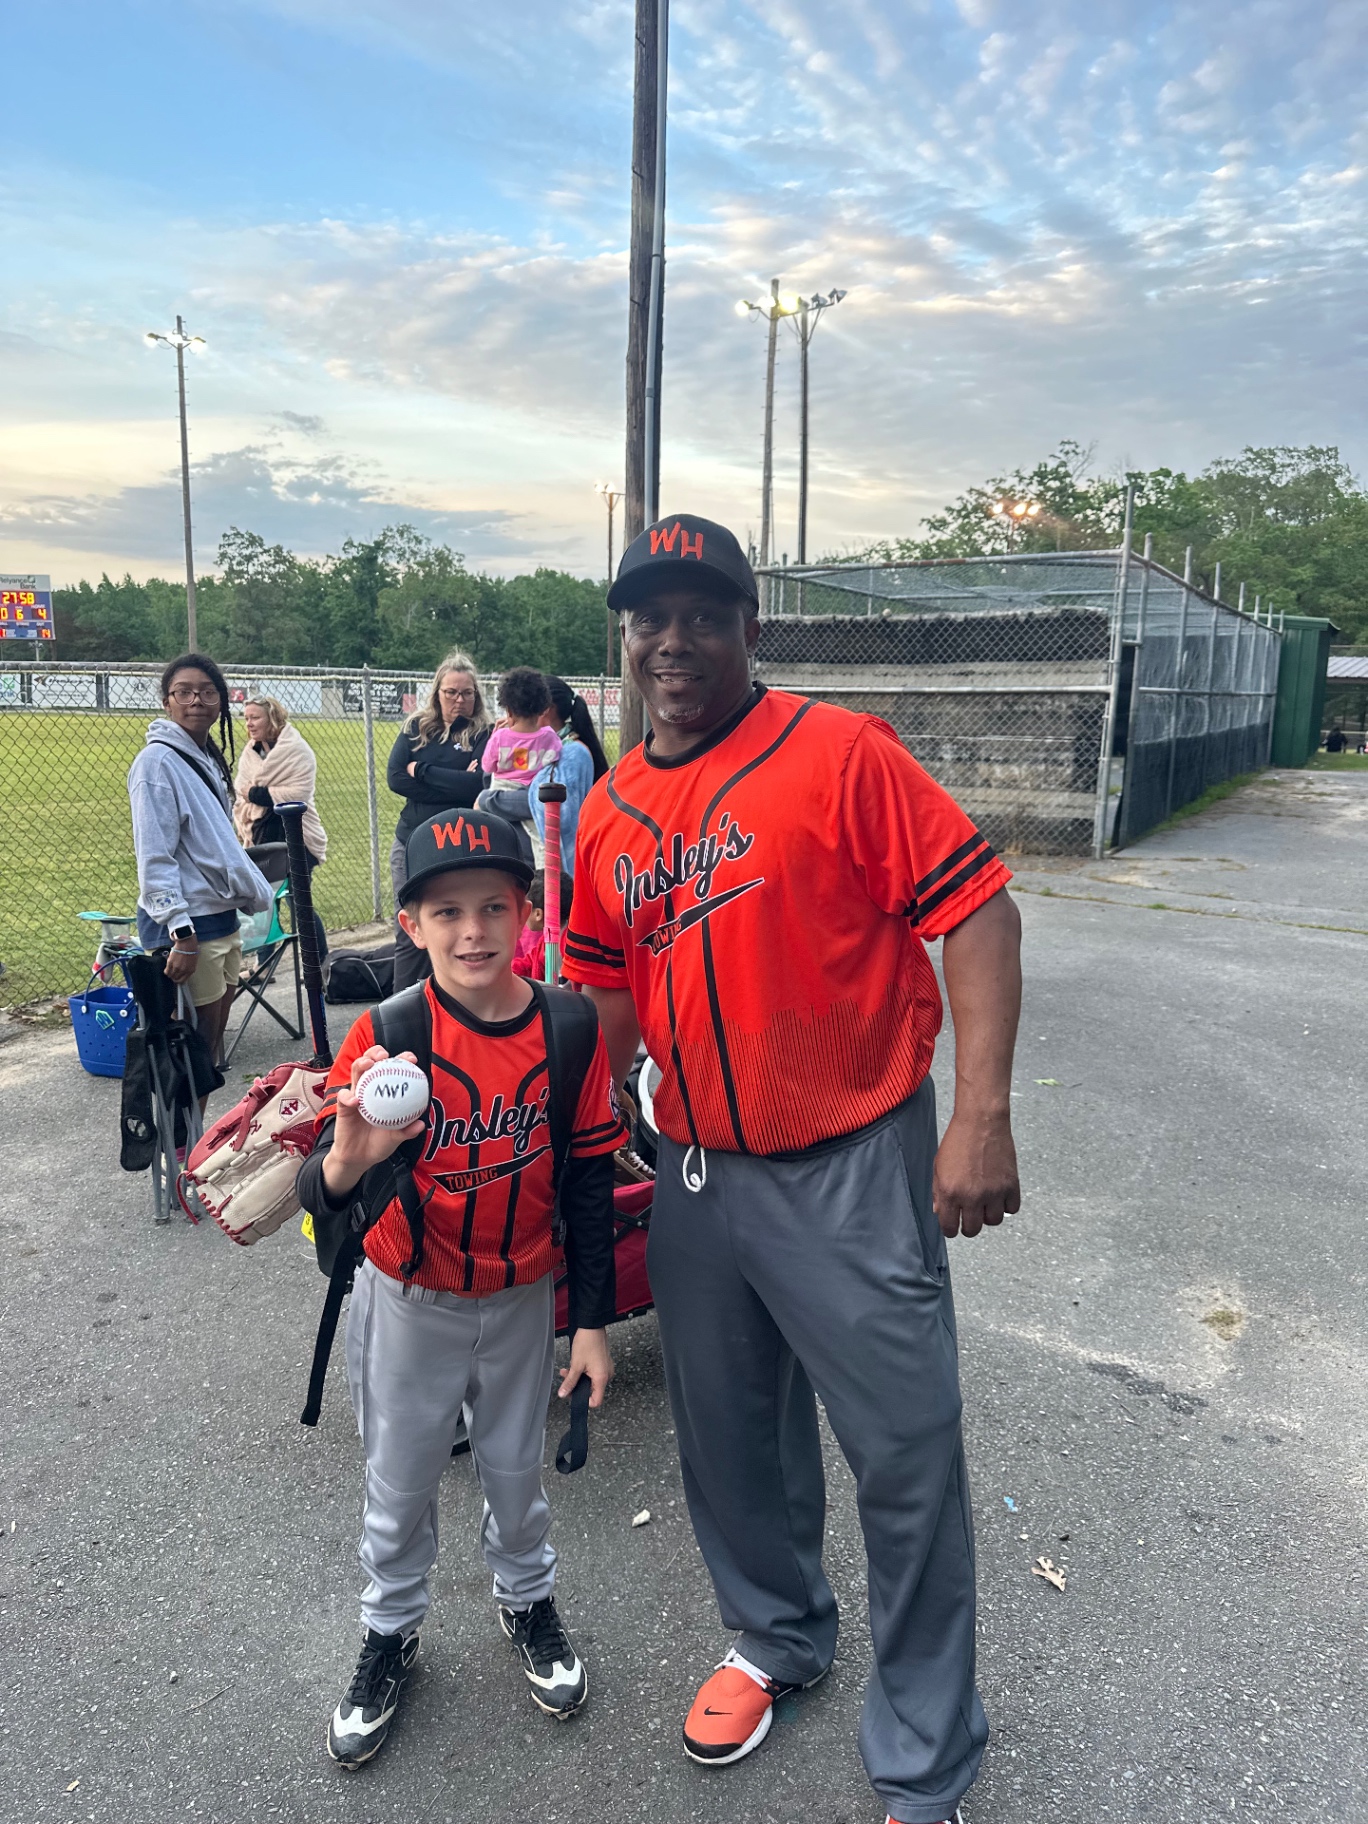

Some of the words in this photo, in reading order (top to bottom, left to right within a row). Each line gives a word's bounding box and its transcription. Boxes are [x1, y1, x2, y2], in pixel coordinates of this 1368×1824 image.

[650, 521, 704, 560] WH
[431, 816, 491, 853] WH
[614, 812, 755, 928] Insley's
[374, 1082, 409, 1099] MVP
[445, 1167, 498, 1190] TOWING
